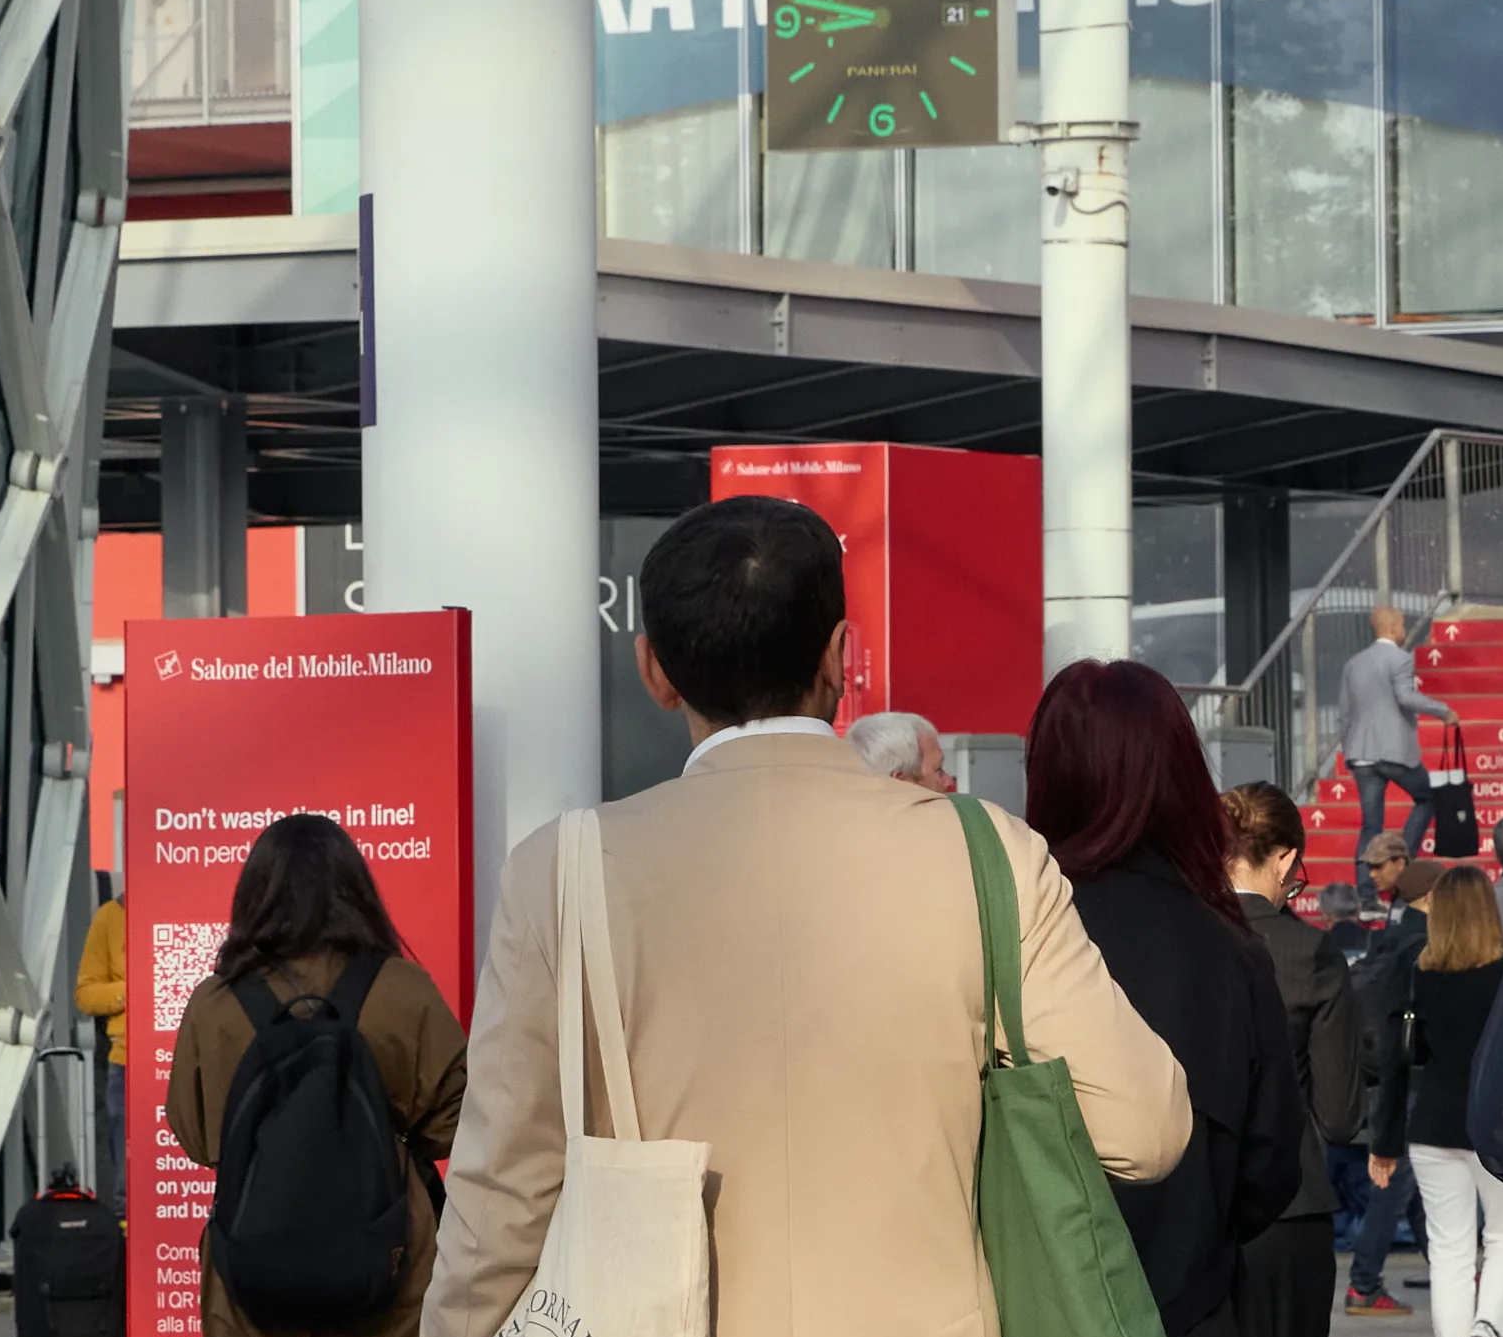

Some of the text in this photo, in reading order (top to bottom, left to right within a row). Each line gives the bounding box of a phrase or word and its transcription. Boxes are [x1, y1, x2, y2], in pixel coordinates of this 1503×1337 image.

[774, 5, 801, 38] 9
[946, 7, 965, 22] 21
[868, 105, 895, 137] 6
[191, 652, 432, 681] Salone del Mobile.Milano
[156, 808, 216, 830] Don't
[347, 805, 365, 826] in
[371, 804, 415, 825] line!
[156, 837, 430, 867] Non perd in coda!
[156, 1156, 199, 1171] show
[156, 1180, 216, 1199] on your
[157, 1202, 187, 1218] and
[157, 1292, 193, 1309] il QR
[157, 1317, 184, 1333] alla
